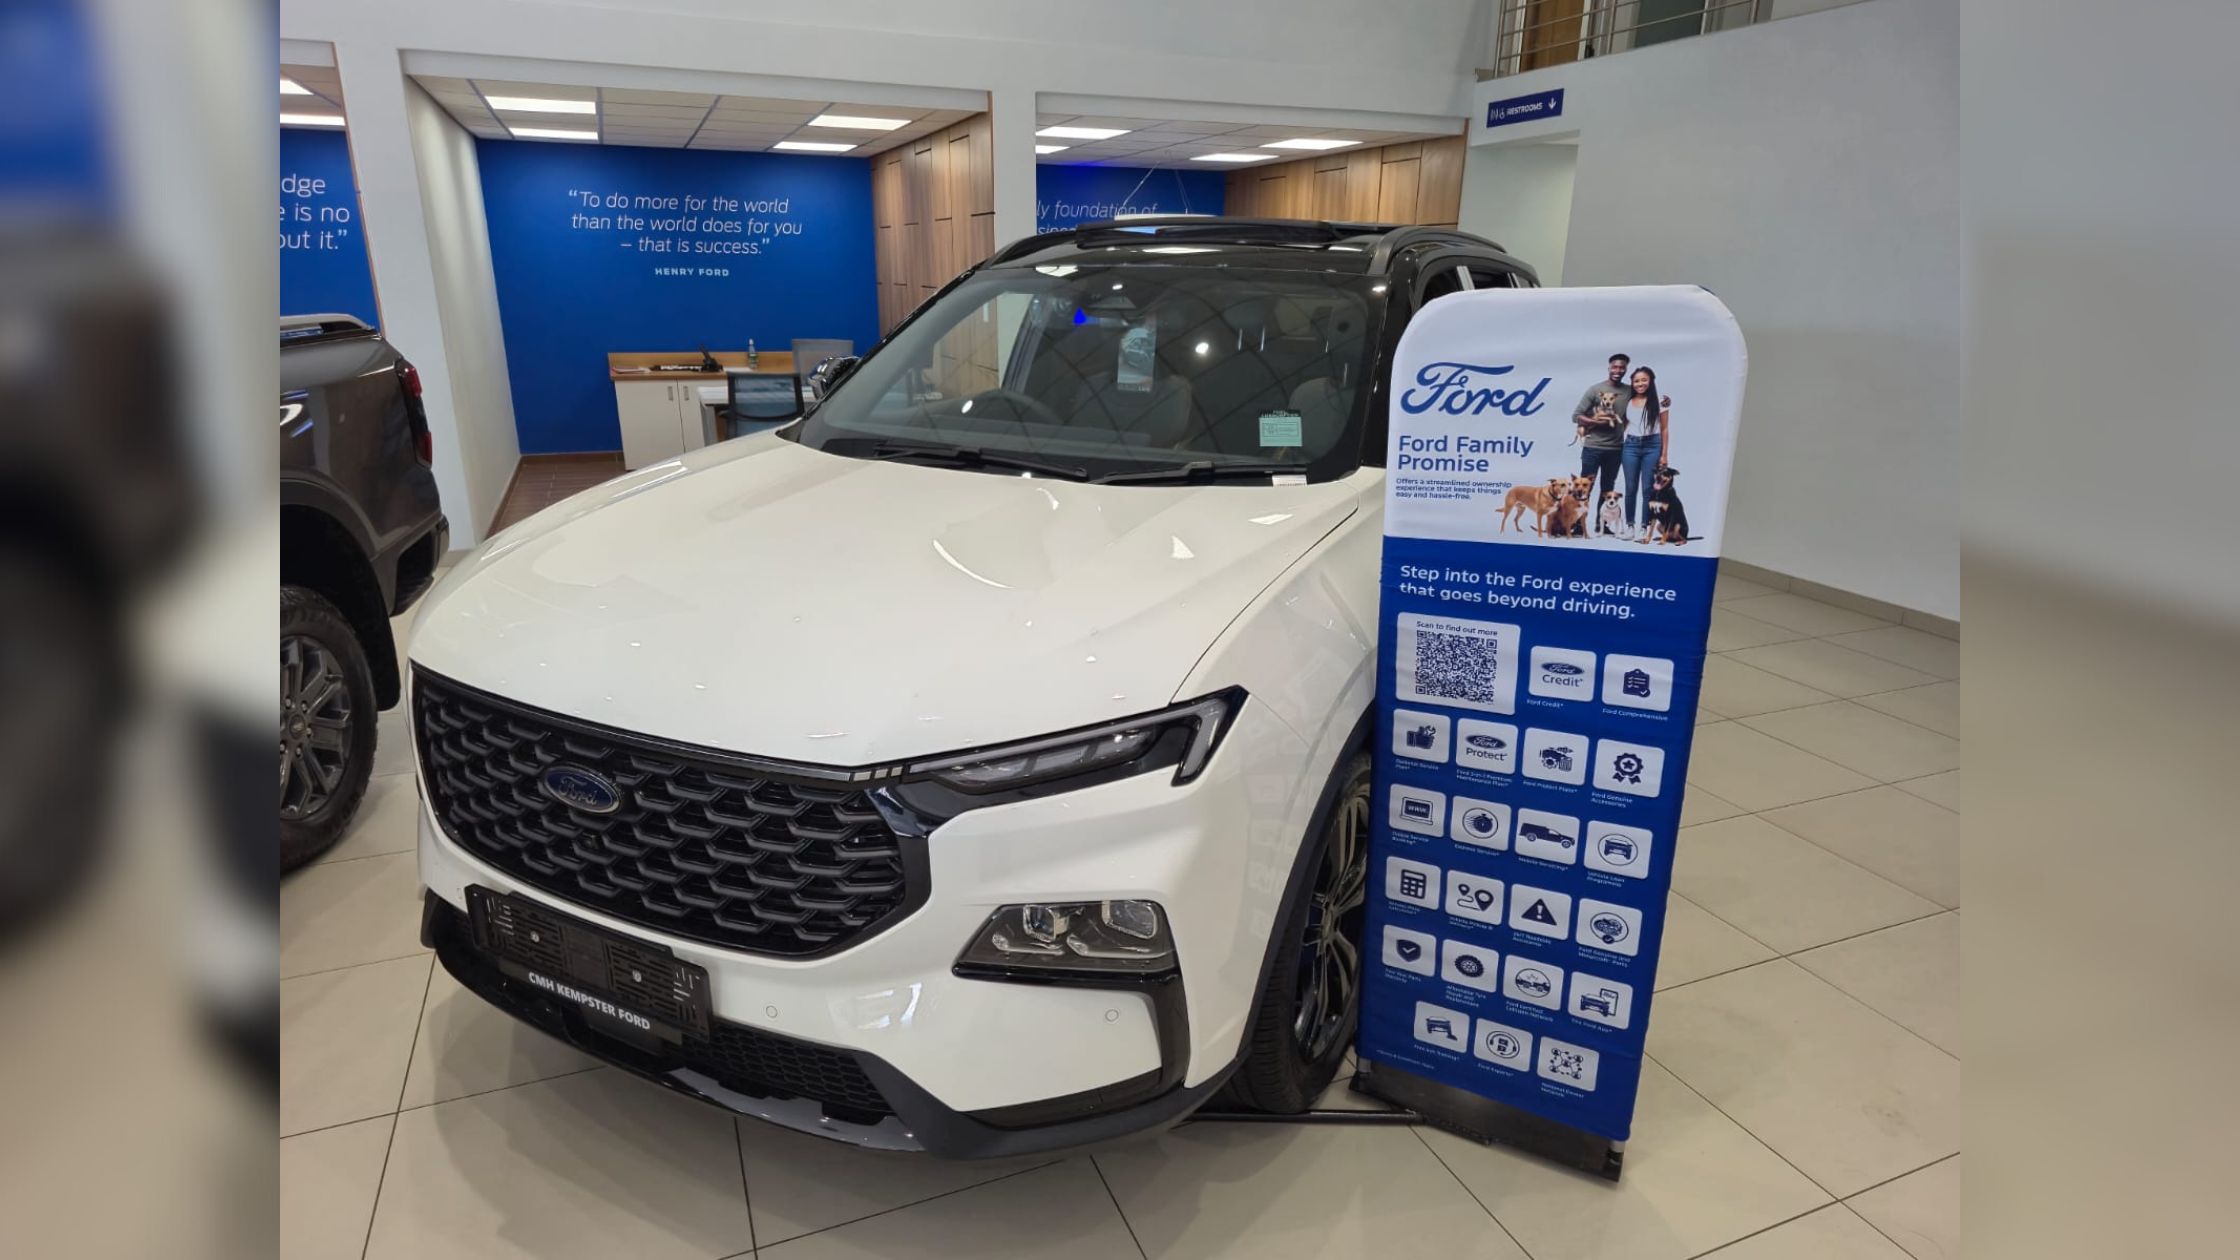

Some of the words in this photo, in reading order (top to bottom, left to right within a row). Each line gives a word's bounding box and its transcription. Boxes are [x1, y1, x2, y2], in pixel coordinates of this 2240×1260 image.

[1506, 102, 1543, 116] RESTROOMS
[281, 173, 326, 198] dge
[294, 202, 312, 221] is
[321, 207, 350, 223] no
[605, 192, 629, 209] do
[634, 195, 679, 210] more
[684, 194, 707, 213] for
[713, 196, 739, 212] the
[744, 198, 789, 214] world
[1054, 200, 1137, 220] foundation
[1141, 203, 1159, 215] of
[571, 213, 611, 230] than
[617, 215, 645, 231] the
[650, 216, 697, 232] world
[703, 217, 742, 233] does
[747, 218, 770, 236] for
[774, 222, 803, 237] you
[639, 236, 672, 252] that
[677, 238, 690, 253] is
[655, 267, 694, 276] HENRY
[699, 268, 729, 277] FORD
[1400, 362, 1552, 416] Ford
[1399, 435, 1448, 453] Ford
[1456, 436, 1534, 458] Family
[1398, 454, 1490, 472] Promise
[1396, 478, 1418, 486] Offers
[1426, 479, 1471, 488] streamlined
[1472, 481, 1513, 490] ownership
[1396, 484, 1435, 494] experience
[1436, 485, 1452, 493] that
[1454, 486, 1476, 495] keeps
[1477, 487, 1502, 495] things
[1401, 565, 1440, 583] Step
[1444, 567, 1480, 585] into
[1485, 572, 1515, 588] the
[1521, 574, 1563, 591] Ford
[1568, 579, 1677, 602] experience
[1400, 582, 1435, 598] that
[1440, 589, 1482, 603] goes
[1487, 590, 1557, 611] beyond
[1562, 596, 1635, 620] driving.
[1416, 621, 1434, 629] Scan
[1445, 624, 1461, 632] find
[559, 775, 597, 805] Ford
[528, 971, 555, 991] CMH
[556, 983, 616, 1018] KEMPSTER
[618, 1008, 651, 1030] FORD
